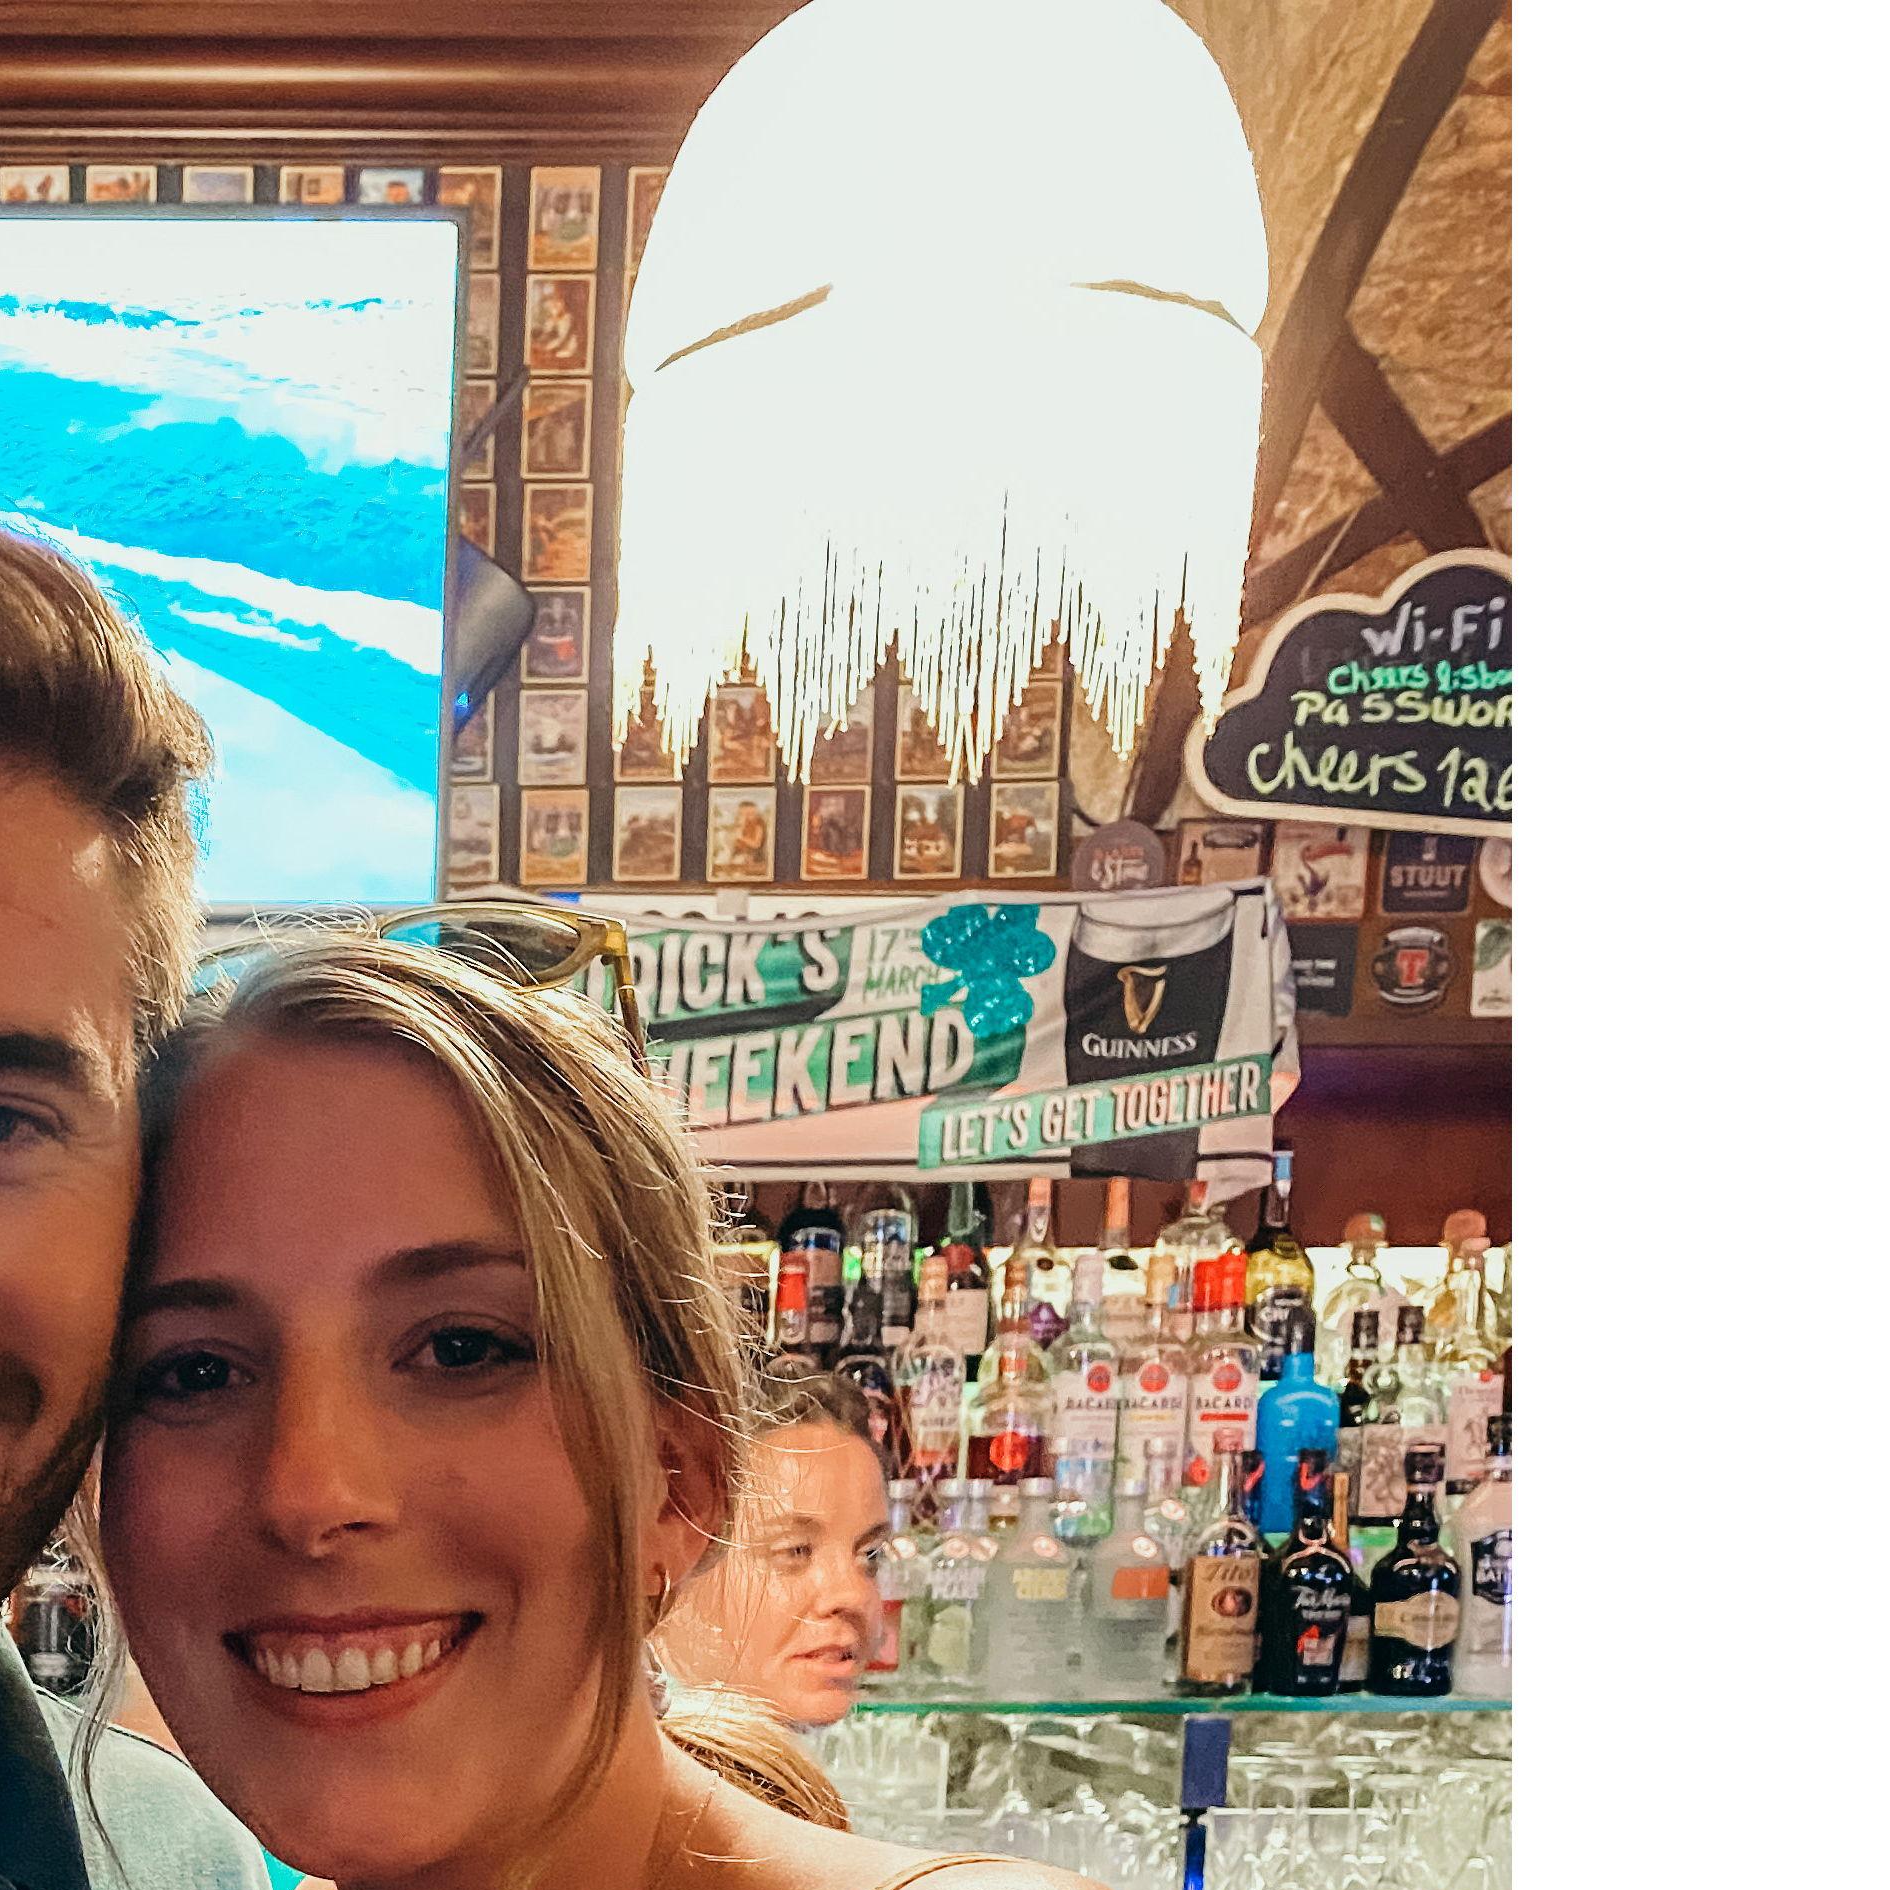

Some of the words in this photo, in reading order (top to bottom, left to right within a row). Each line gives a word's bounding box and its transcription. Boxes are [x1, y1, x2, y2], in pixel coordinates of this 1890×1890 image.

[1360, 597, 1506, 656] Wi-Fi
[1389, 865, 1466, 888] STOUT
[1081, 1029, 1198, 1060] GUINNESS
[940, 1097, 1030, 1163] LET'S
[1040, 1085, 1103, 1141] GET
[1109, 1061, 1263, 1133] TOGETHER
